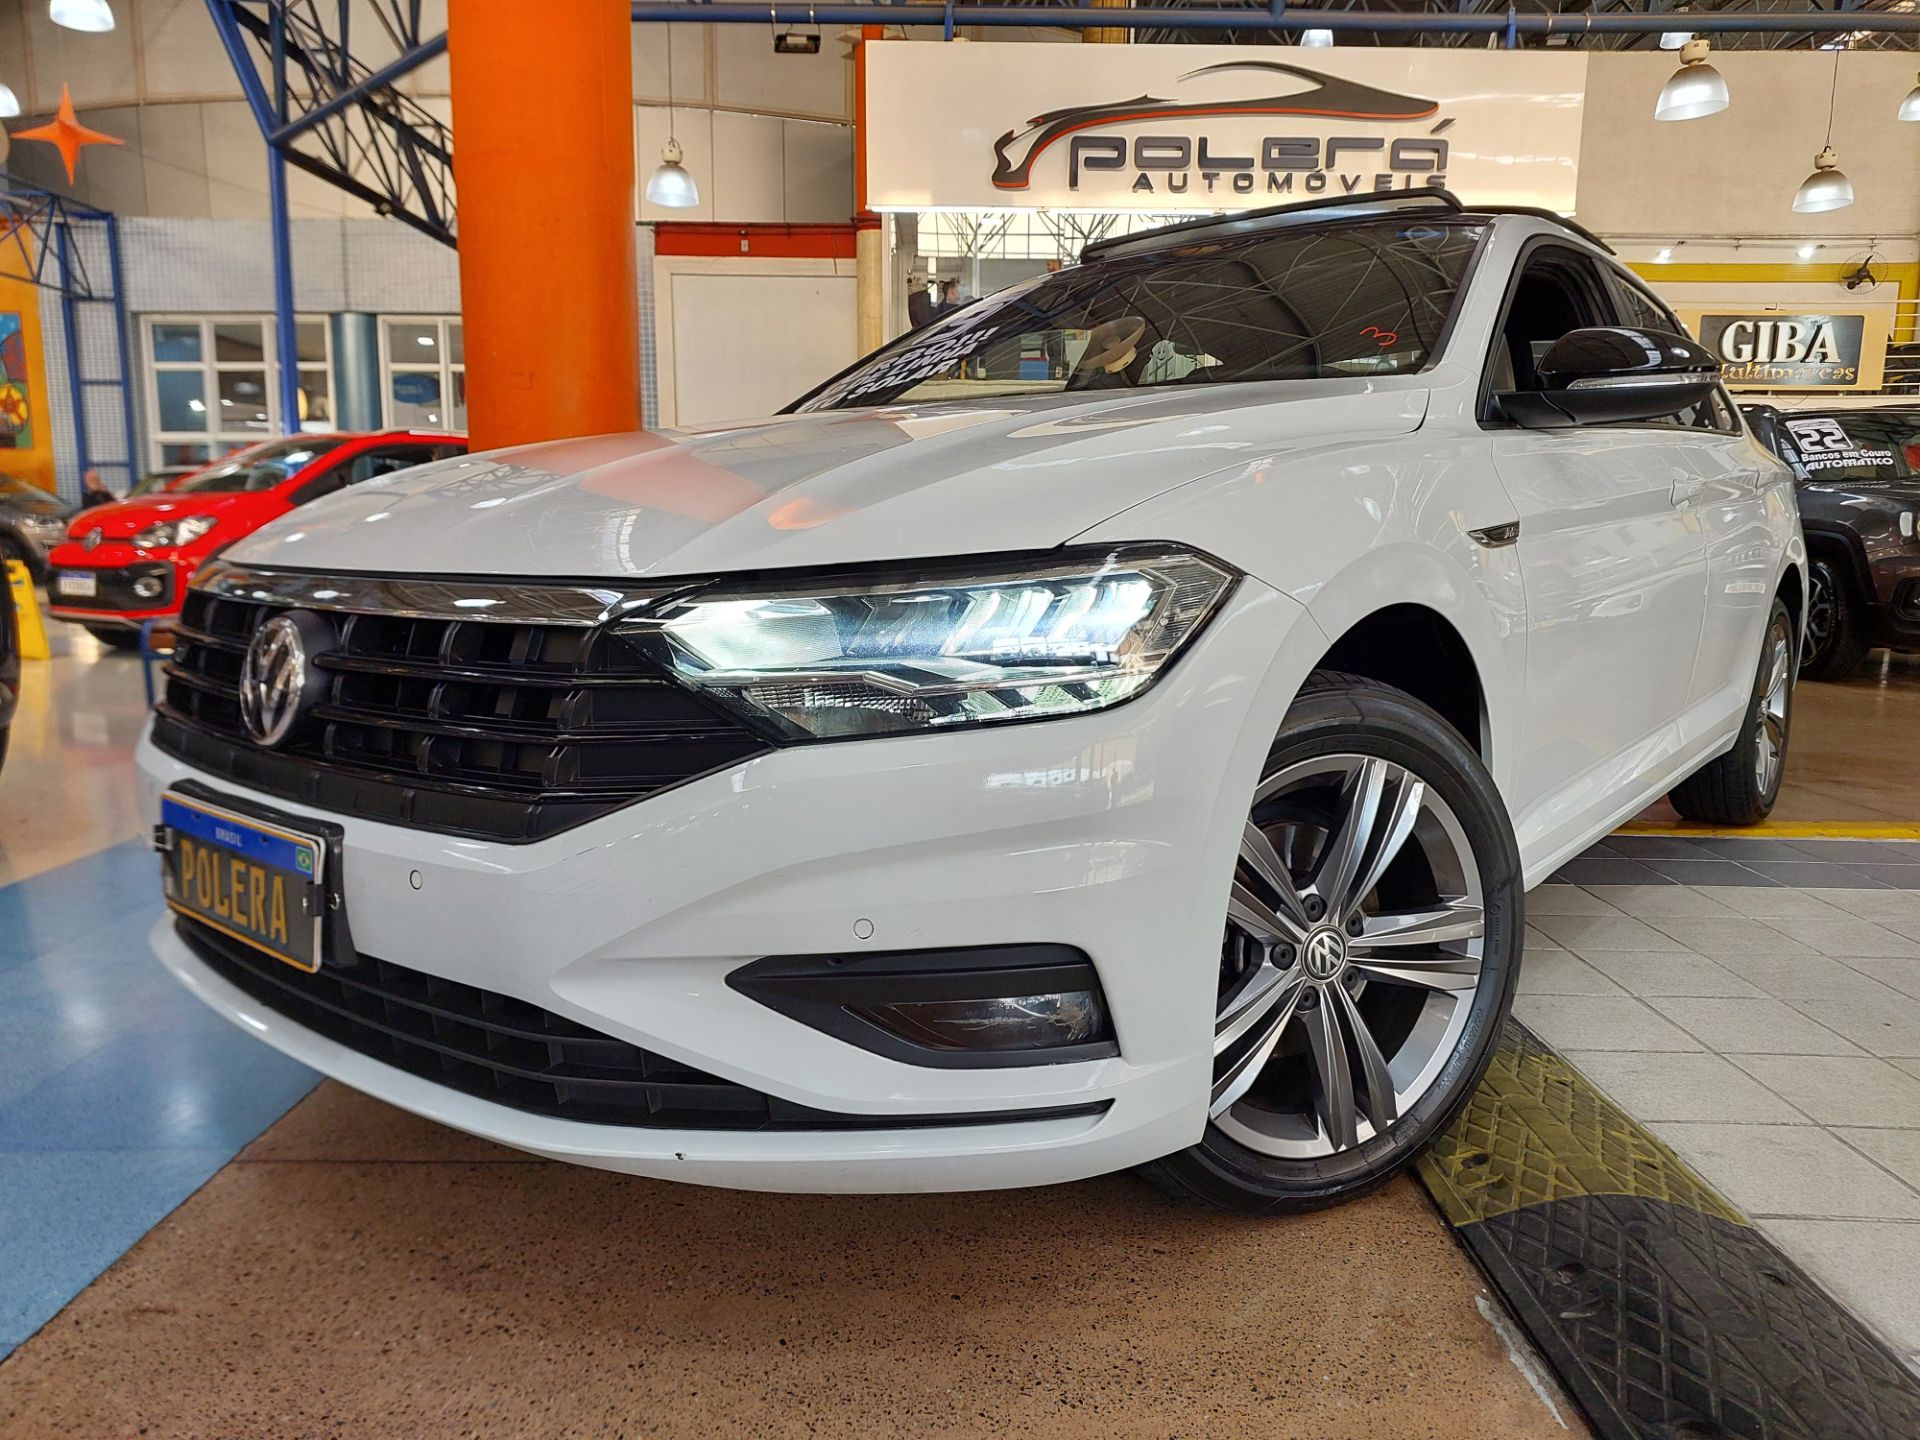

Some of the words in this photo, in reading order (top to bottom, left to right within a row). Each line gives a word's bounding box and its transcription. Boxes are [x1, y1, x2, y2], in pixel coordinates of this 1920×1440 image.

[1132, 169, 1447, 194] AUTOMÓVEIS
[1360, 326, 1397, 346] 3
[1721, 320, 1841, 364] GIBA
[890, 341, 979, 378] LINHA
[847, 358, 959, 400] SOLAR
[1798, 429, 1848, 450] 22
[1801, 451, 1840, 462] Bancos
[1860, 449, 1892, 457] Couro
[180, 839, 288, 945] POLERA
